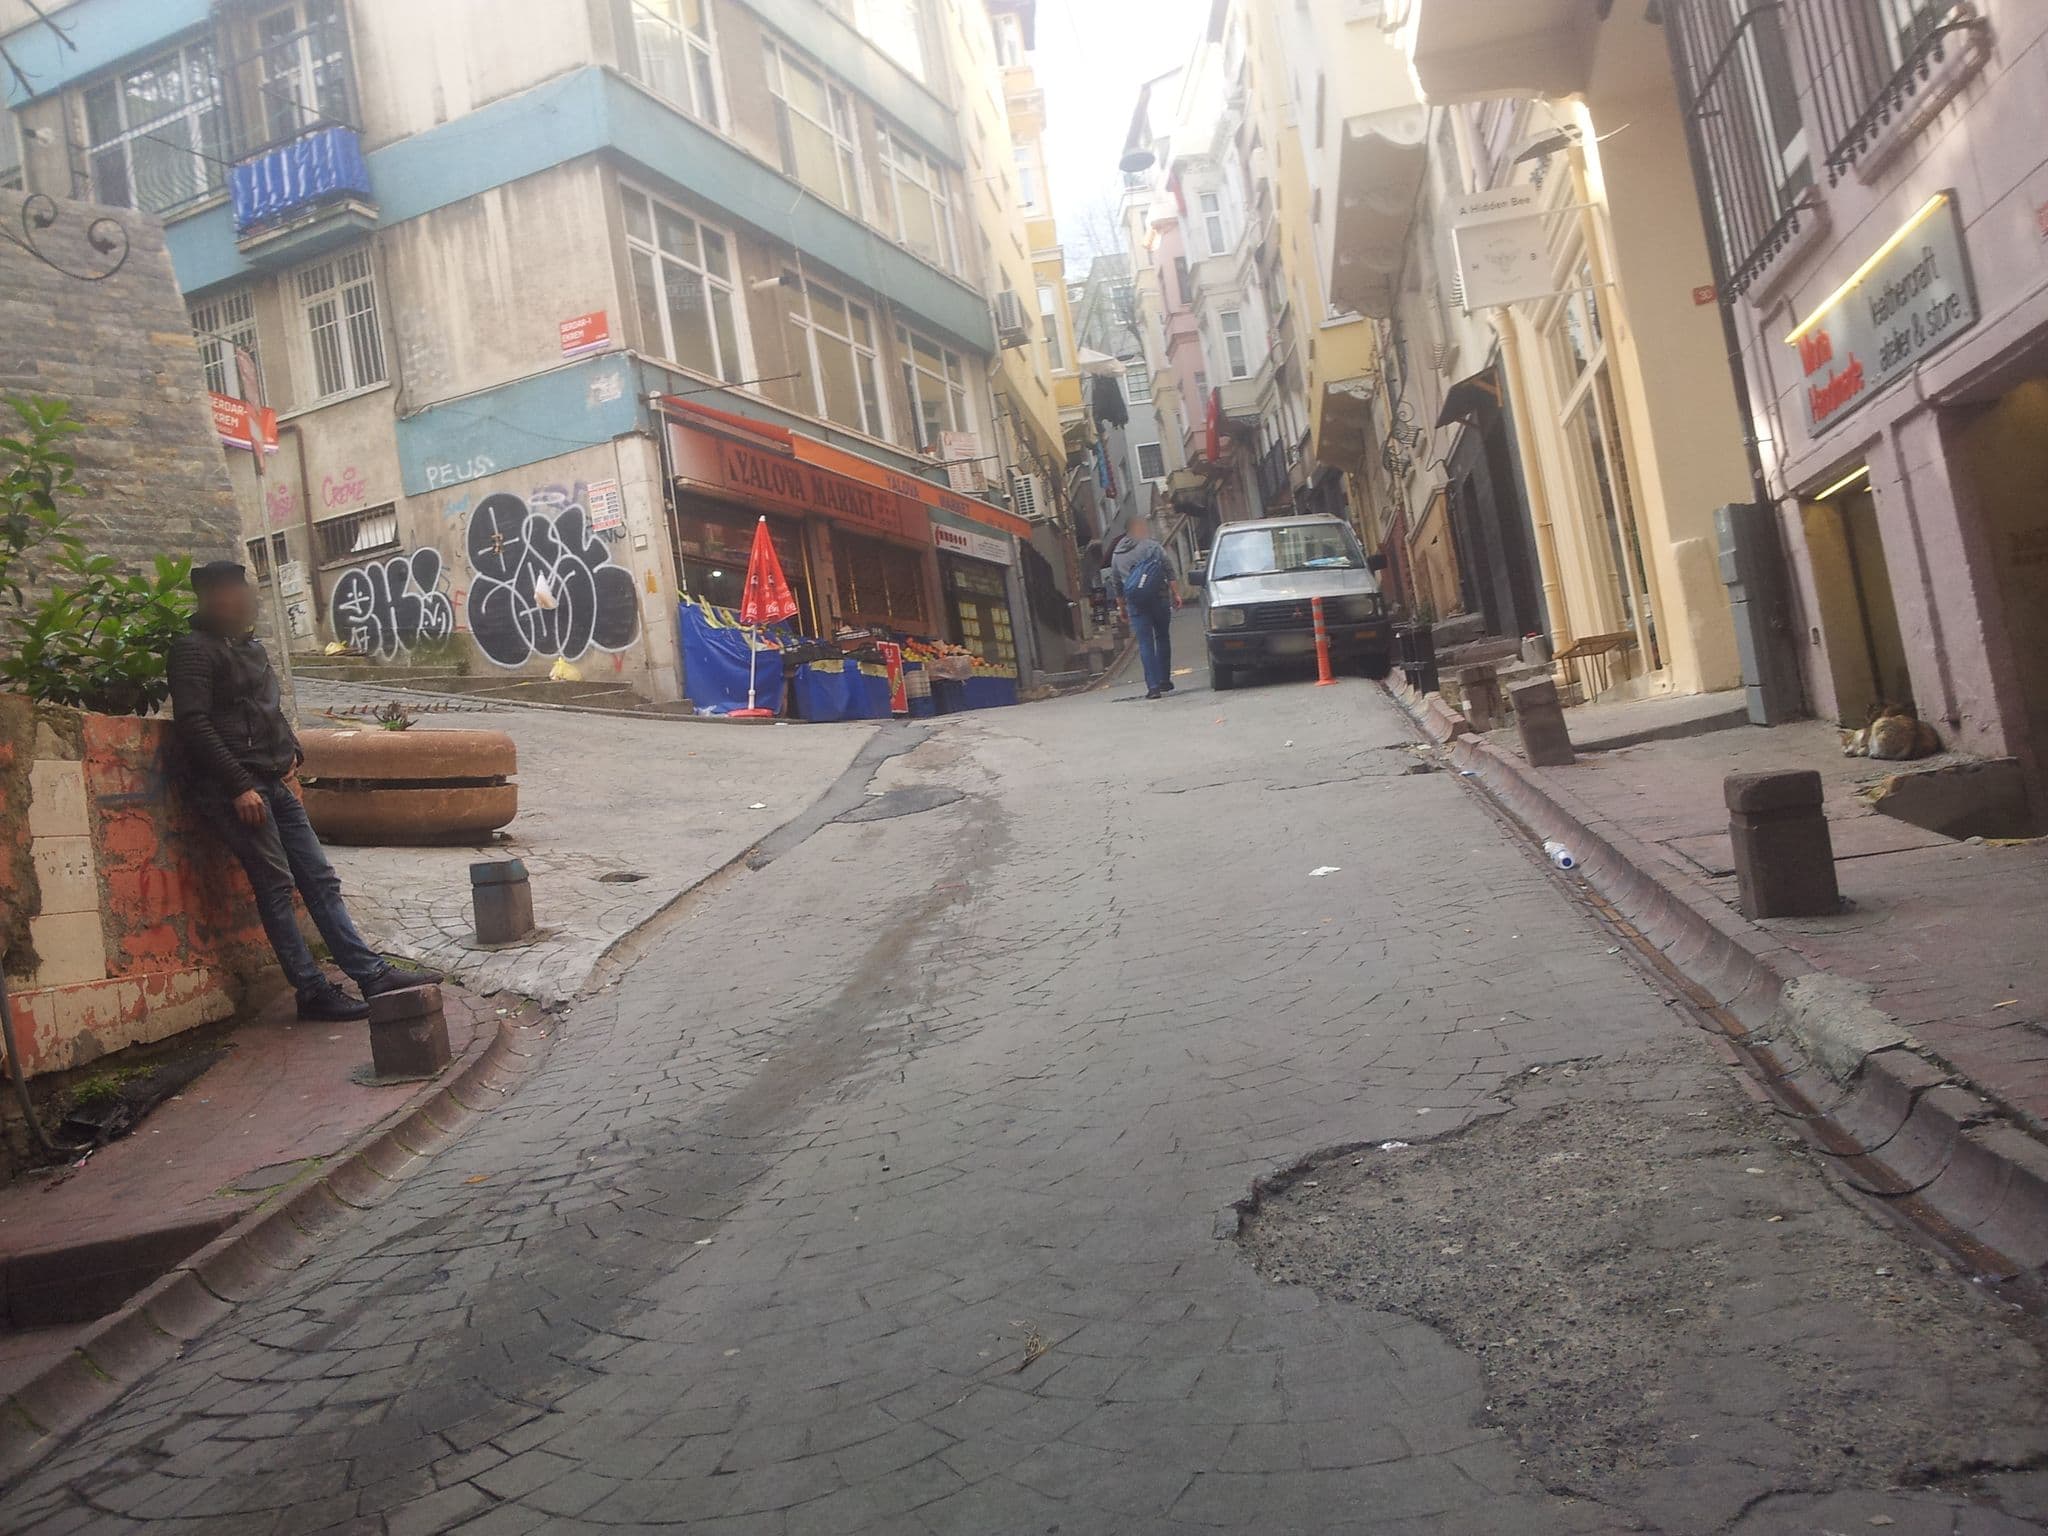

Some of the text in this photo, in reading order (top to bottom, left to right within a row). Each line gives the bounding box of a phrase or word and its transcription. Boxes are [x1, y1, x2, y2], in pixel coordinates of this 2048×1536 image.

[214, 412, 239, 428] KREM
[736, 450, 805, 500] YALOVA
[812, 474, 876, 520] MARKET
